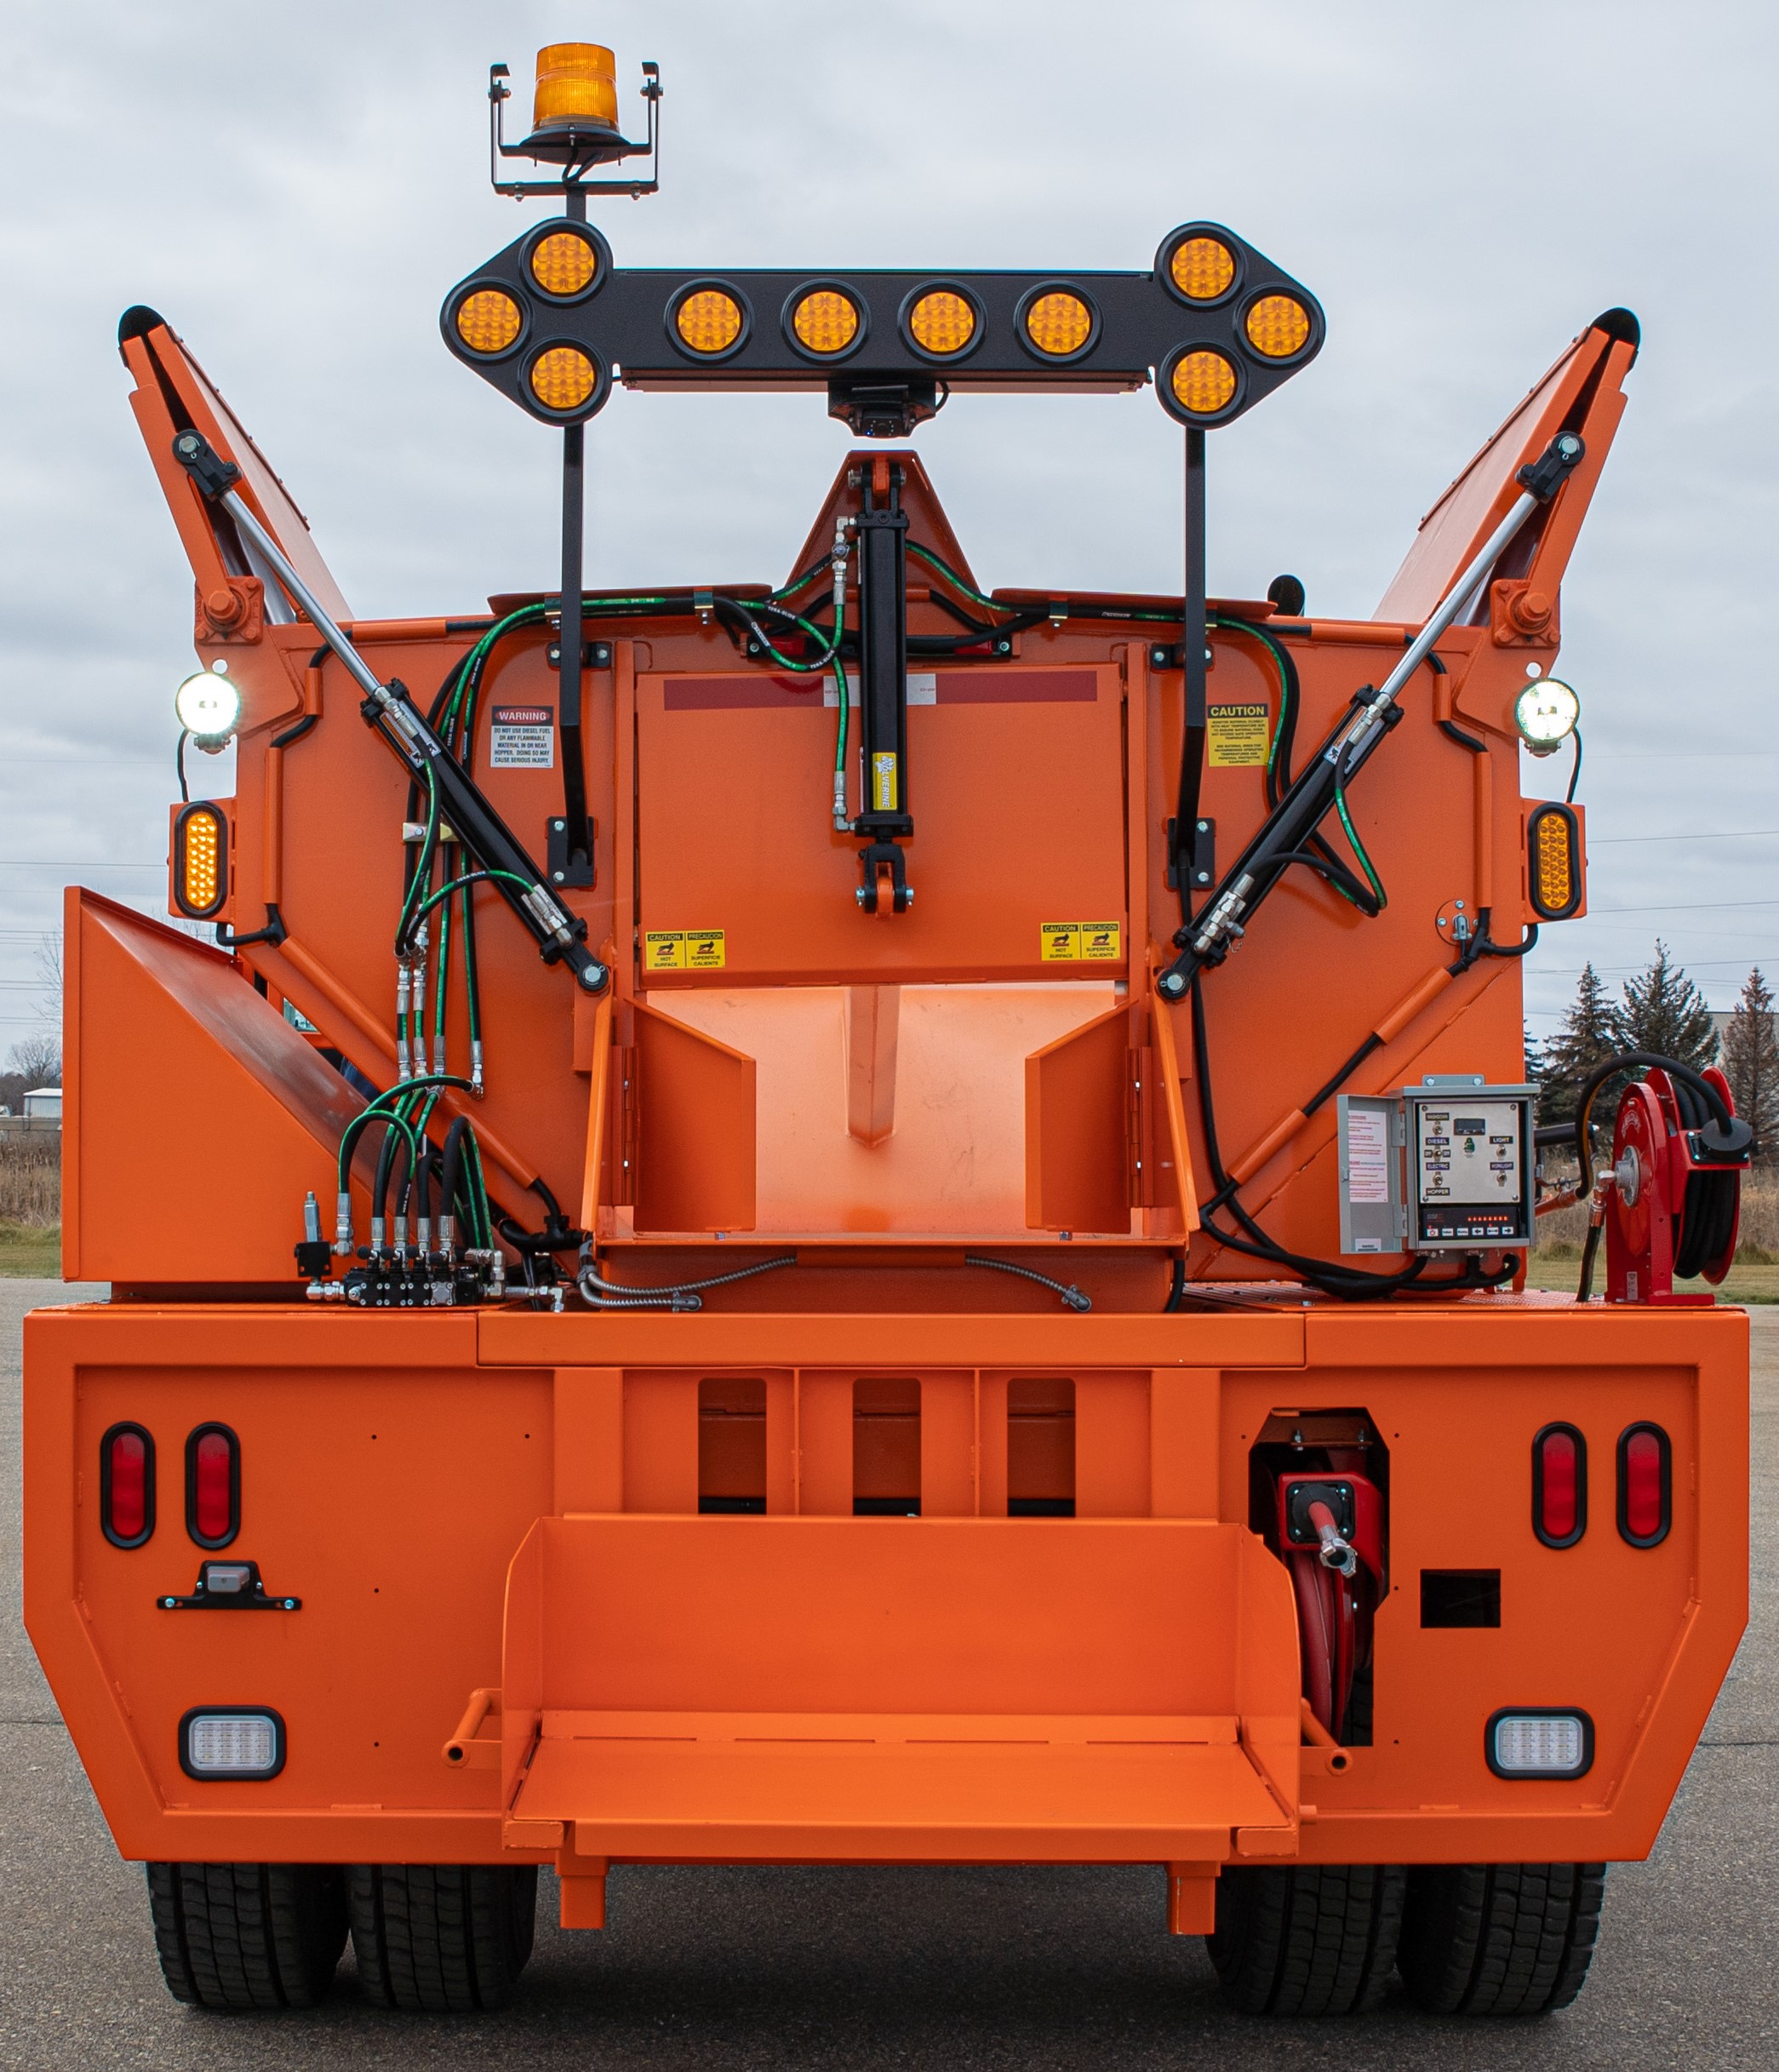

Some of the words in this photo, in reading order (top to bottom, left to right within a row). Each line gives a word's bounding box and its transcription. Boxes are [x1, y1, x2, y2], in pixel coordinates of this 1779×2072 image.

[499, 712, 546, 720] WARNING
[1210, 706, 1265, 716] CAUTION
[881, 756, 890, 808] WOLVERINE
